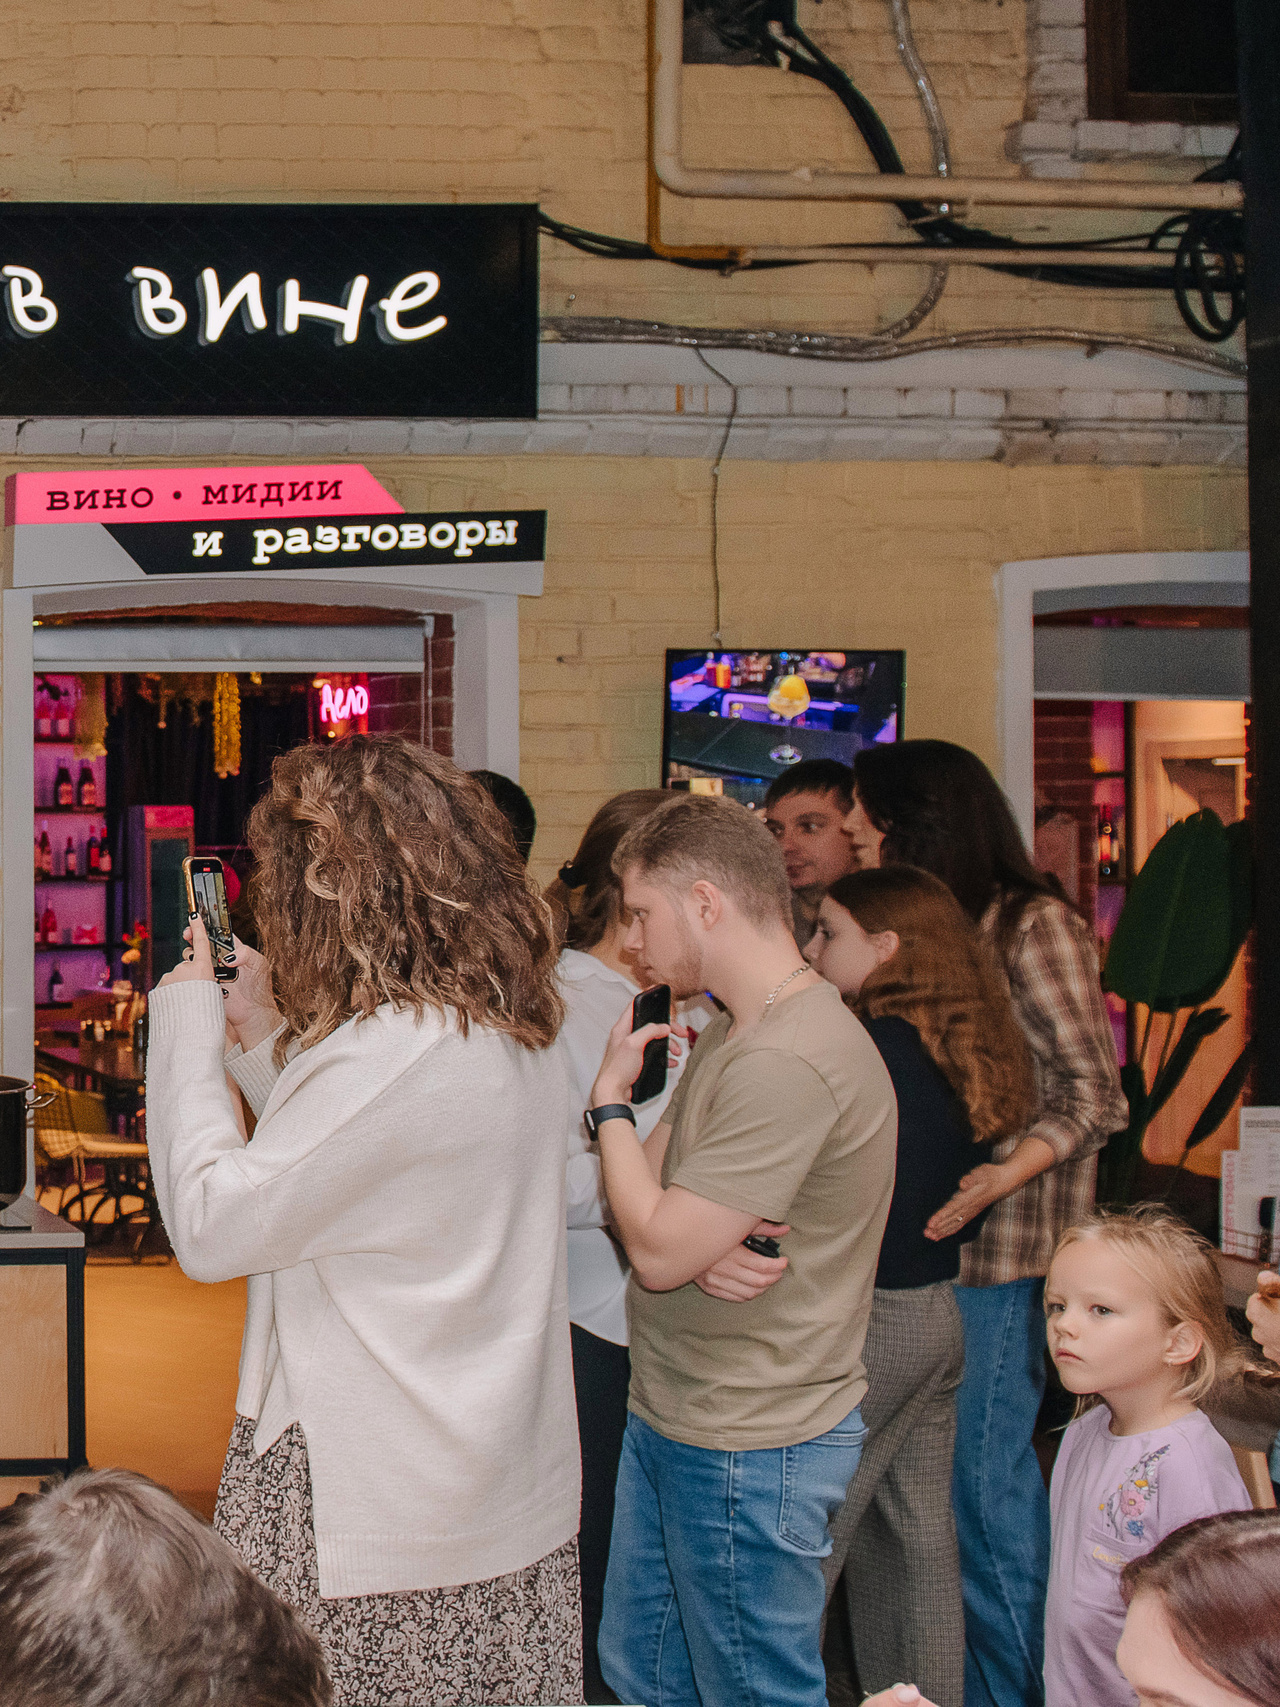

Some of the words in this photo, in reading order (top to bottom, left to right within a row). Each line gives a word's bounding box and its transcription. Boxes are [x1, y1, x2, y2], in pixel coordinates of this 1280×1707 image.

[1, 265, 58, 334] в
[131, 266, 447, 344] вине
[192, 530, 224, 558] и
[252, 518, 519, 565] разговоры
